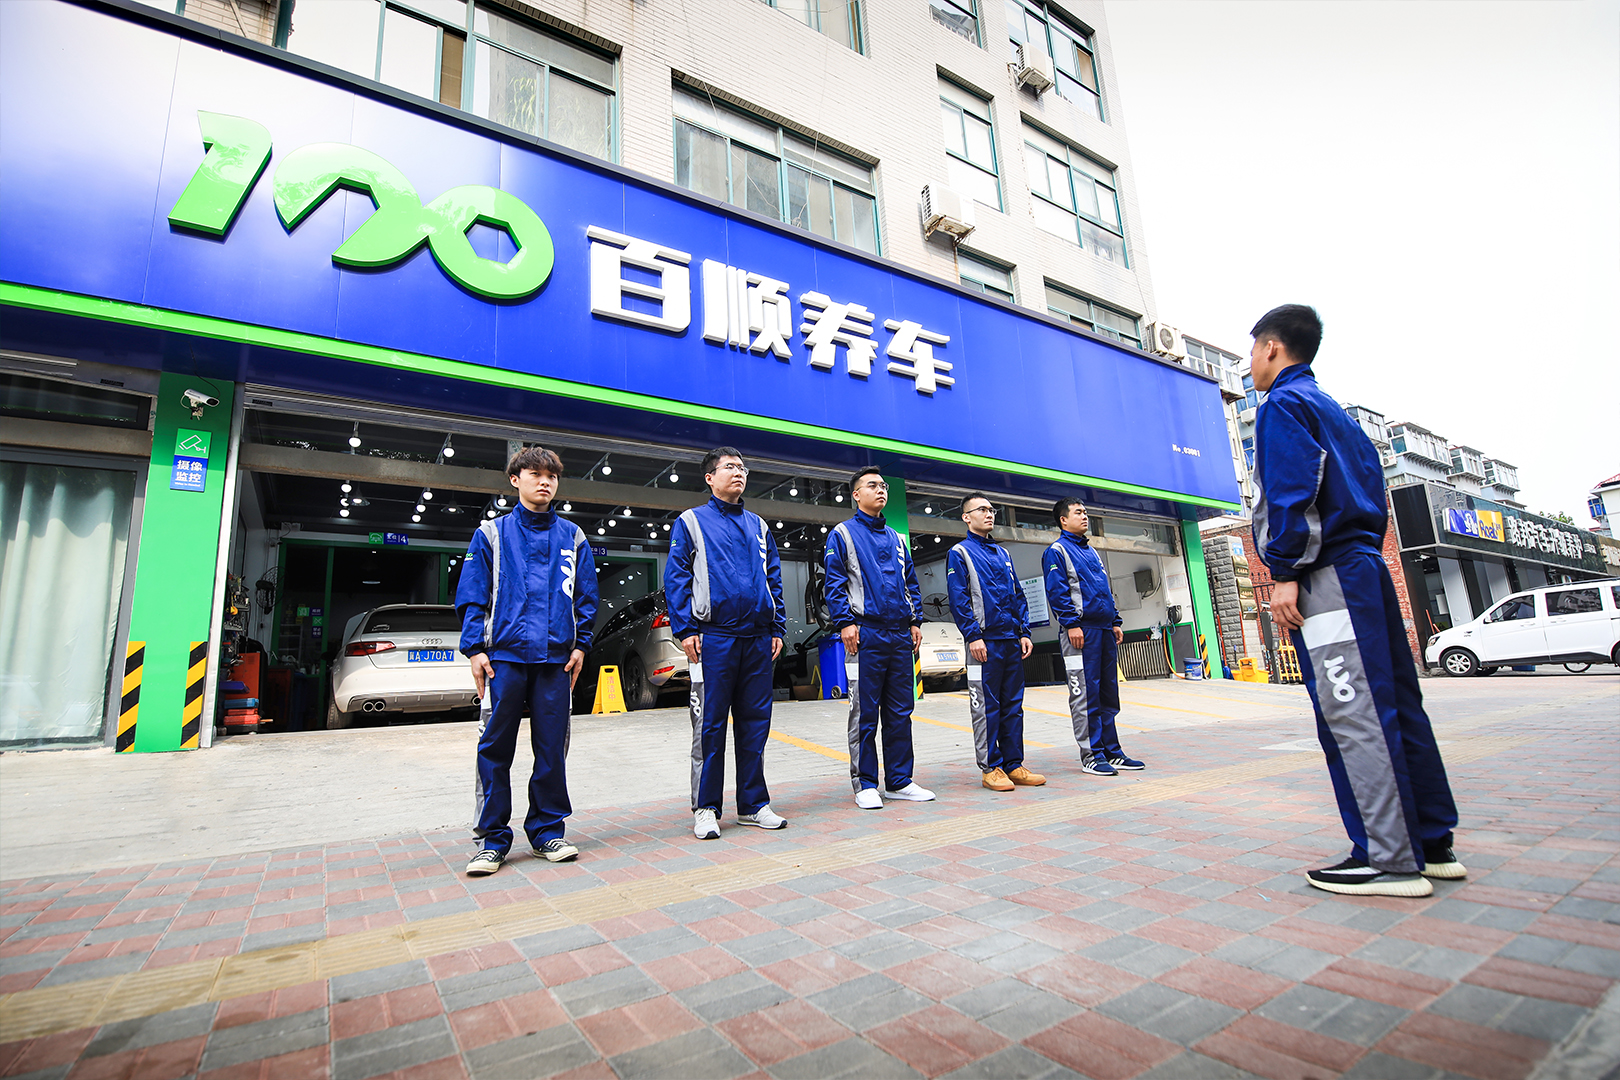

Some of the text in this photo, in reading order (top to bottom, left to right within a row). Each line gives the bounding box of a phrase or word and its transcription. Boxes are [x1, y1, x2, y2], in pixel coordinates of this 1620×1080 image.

[586, 224, 956, 395] 百顺养车
[176, 459, 203, 471] 摄像
[174, 471, 202, 483] 监控
[606, 676, 616, 701] 清洁中
